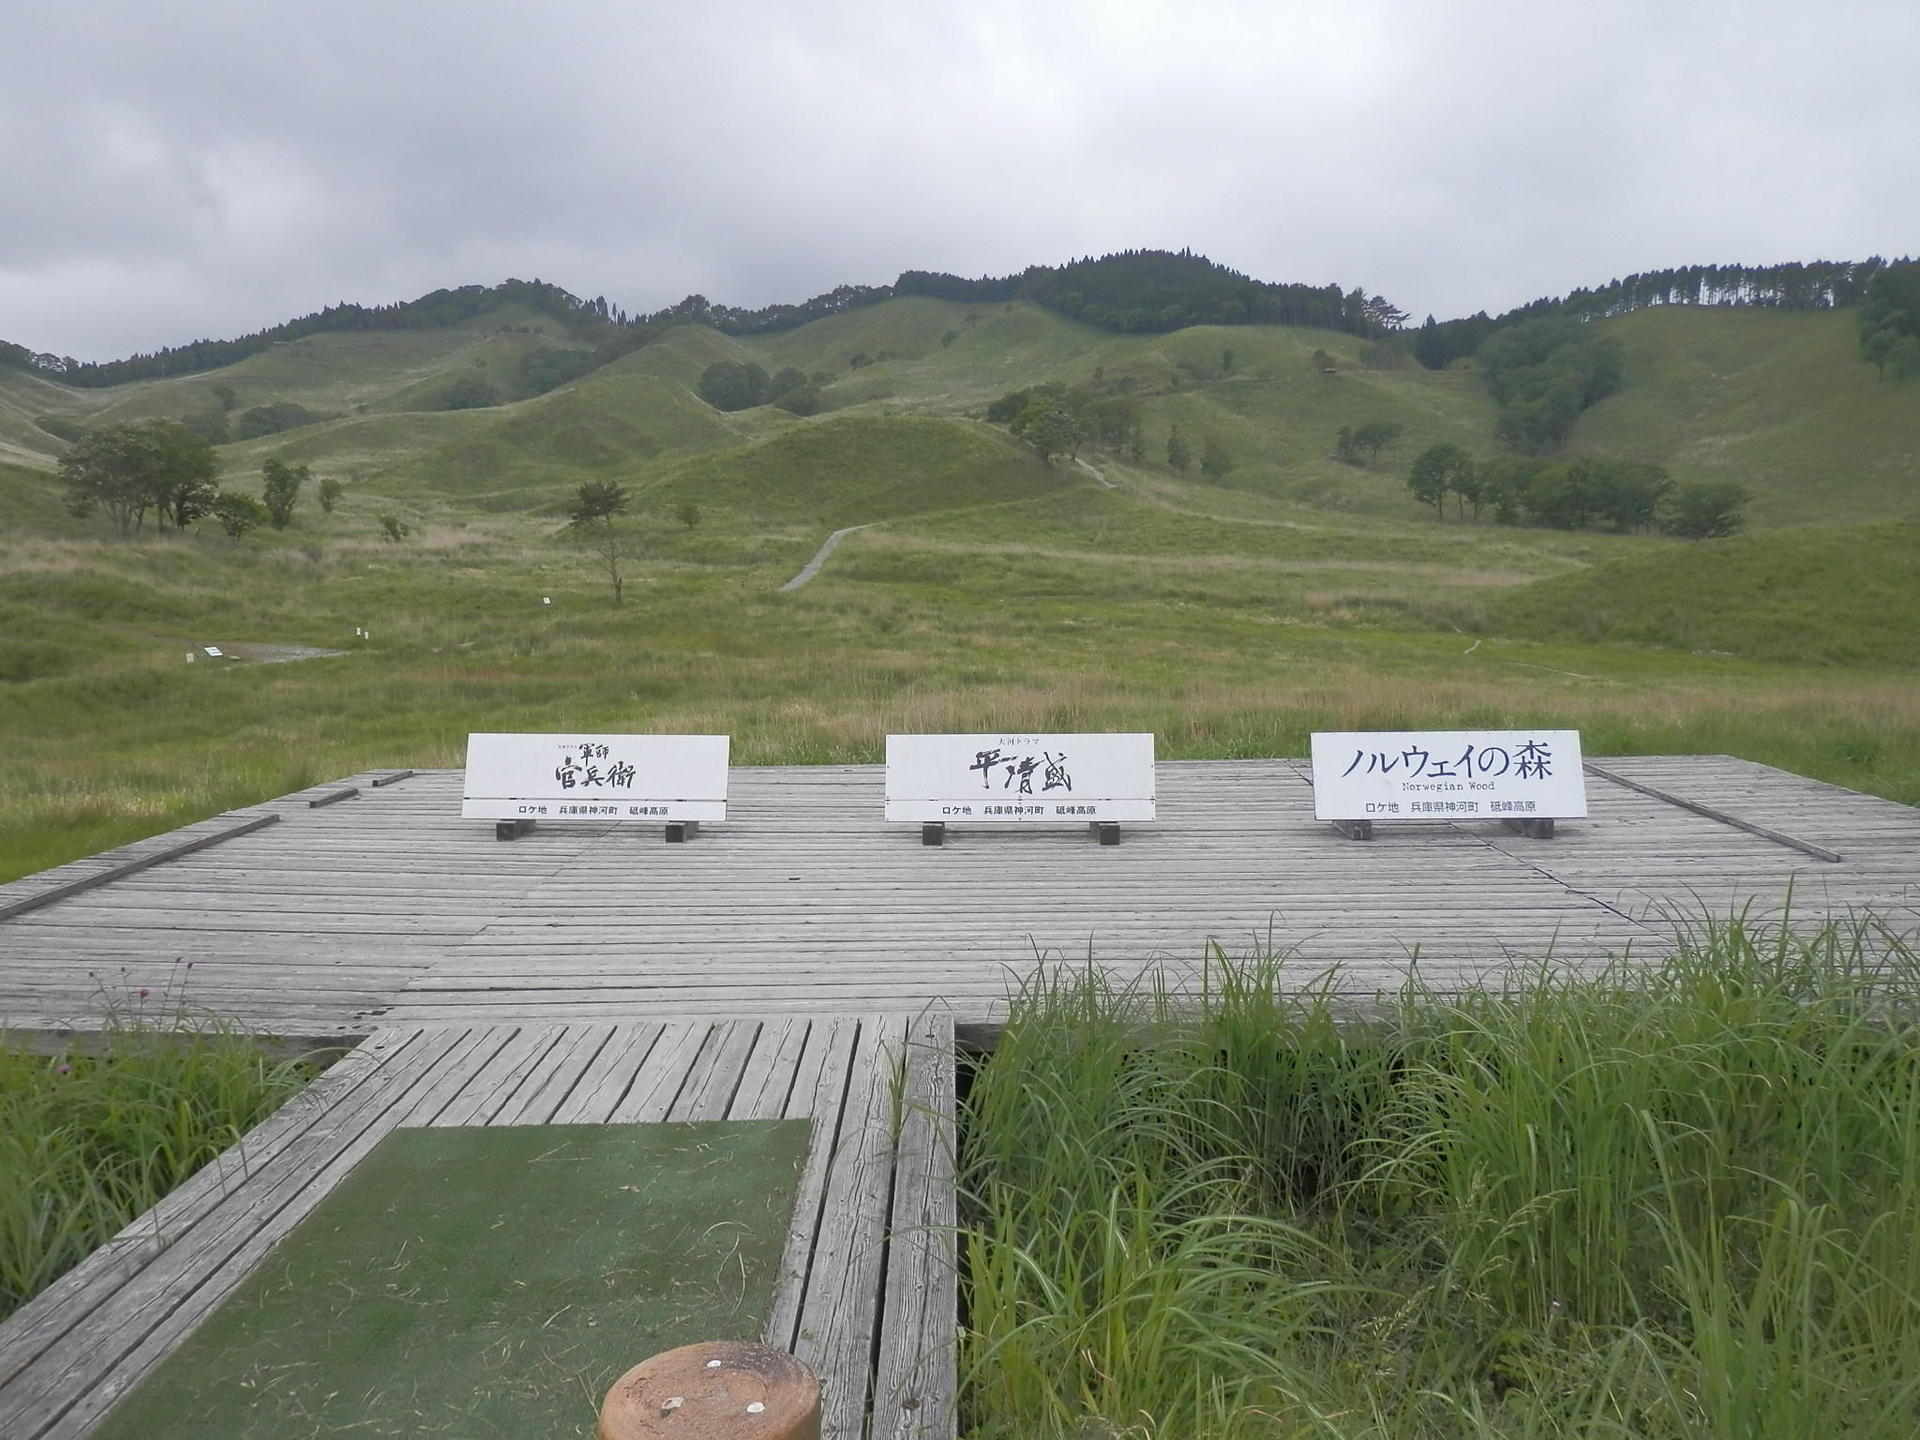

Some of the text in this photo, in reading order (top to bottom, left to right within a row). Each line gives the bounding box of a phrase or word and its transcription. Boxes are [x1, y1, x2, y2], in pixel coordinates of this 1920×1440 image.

[998, 737, 1040, 746] 大河ドラマ
[578, 743, 611, 766] 軍師
[1341, 740, 1553, 780] ノルウェイの森
[555, 756, 636, 790] 官兵衛
[969, 748, 1072, 794] 平清盛
[1402, 781, 1496, 792] Norwegian Wood
[518, 805, 669, 817] ロケ地 兵庫県神河町 砥峰高原
[941, 805, 1096, 816] ロケ地 兵庫県神河町 砥峰高原
[1365, 800, 1536, 813] ロケ地 兵庫県神河町 砥峰高原
